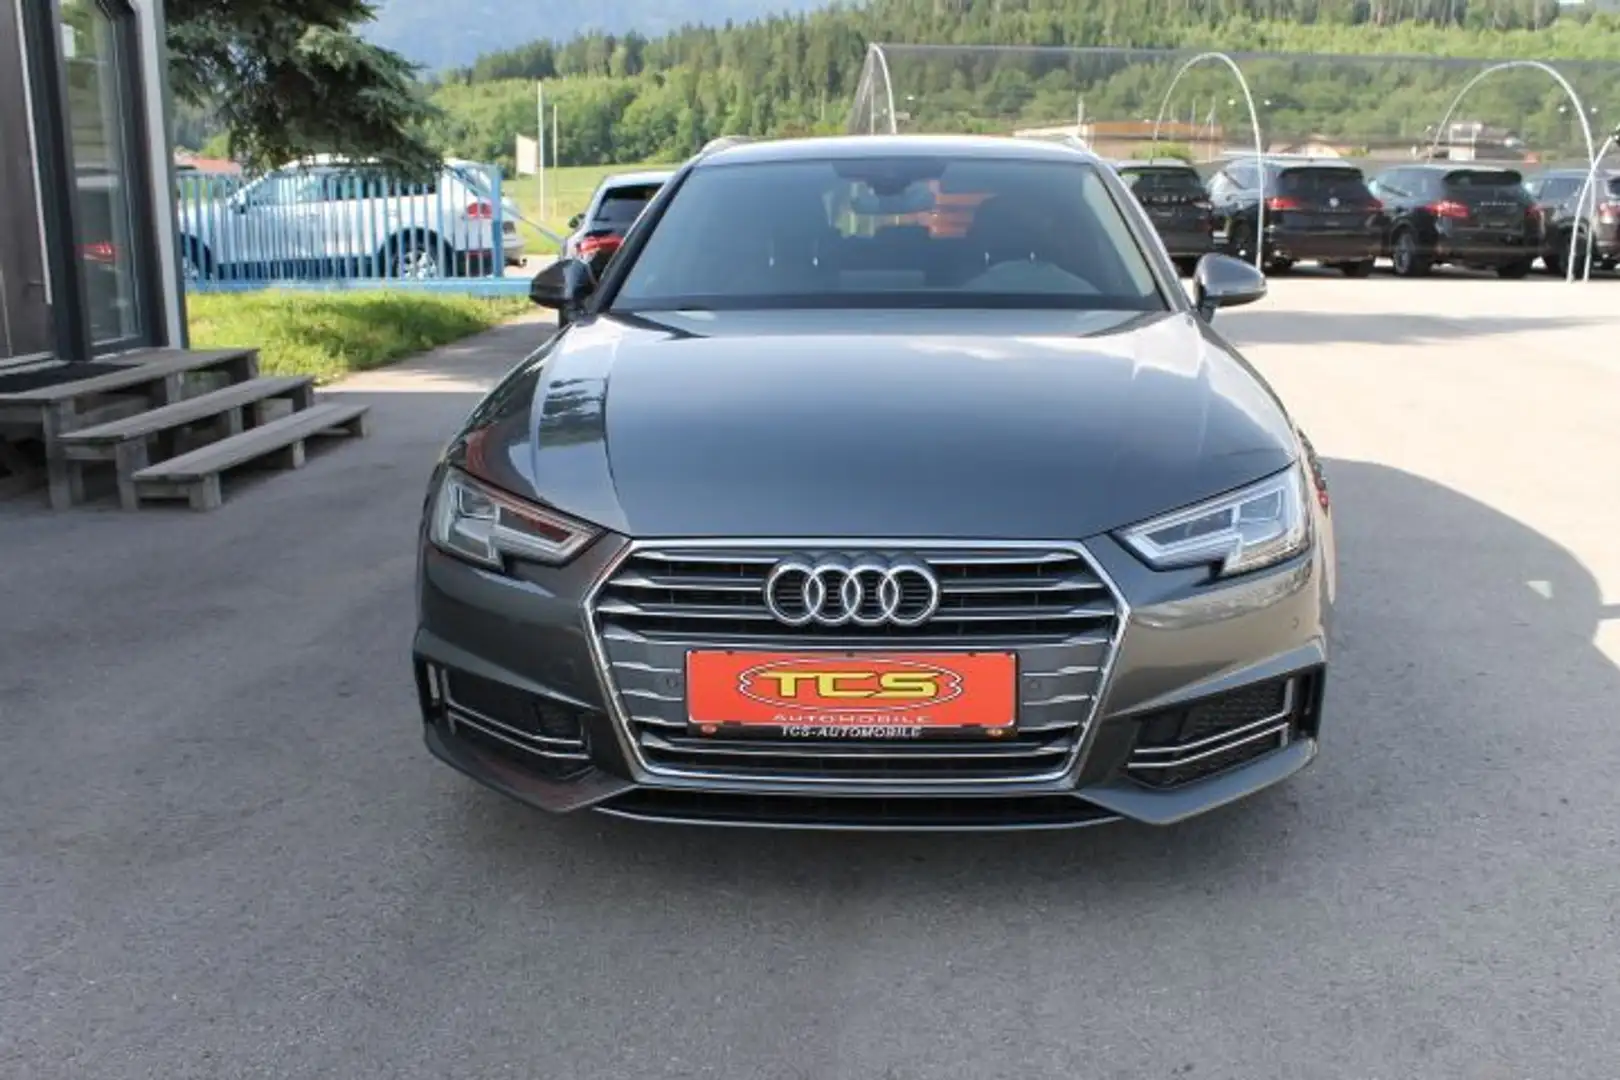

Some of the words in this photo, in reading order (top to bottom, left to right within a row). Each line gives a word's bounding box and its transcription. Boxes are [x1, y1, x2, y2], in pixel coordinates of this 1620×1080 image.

[760, 671, 944, 698] TCS
[772, 714, 932, 724] AUTOMOBILE
[781, 725, 922, 738] TCS-AUTOMOBILE
